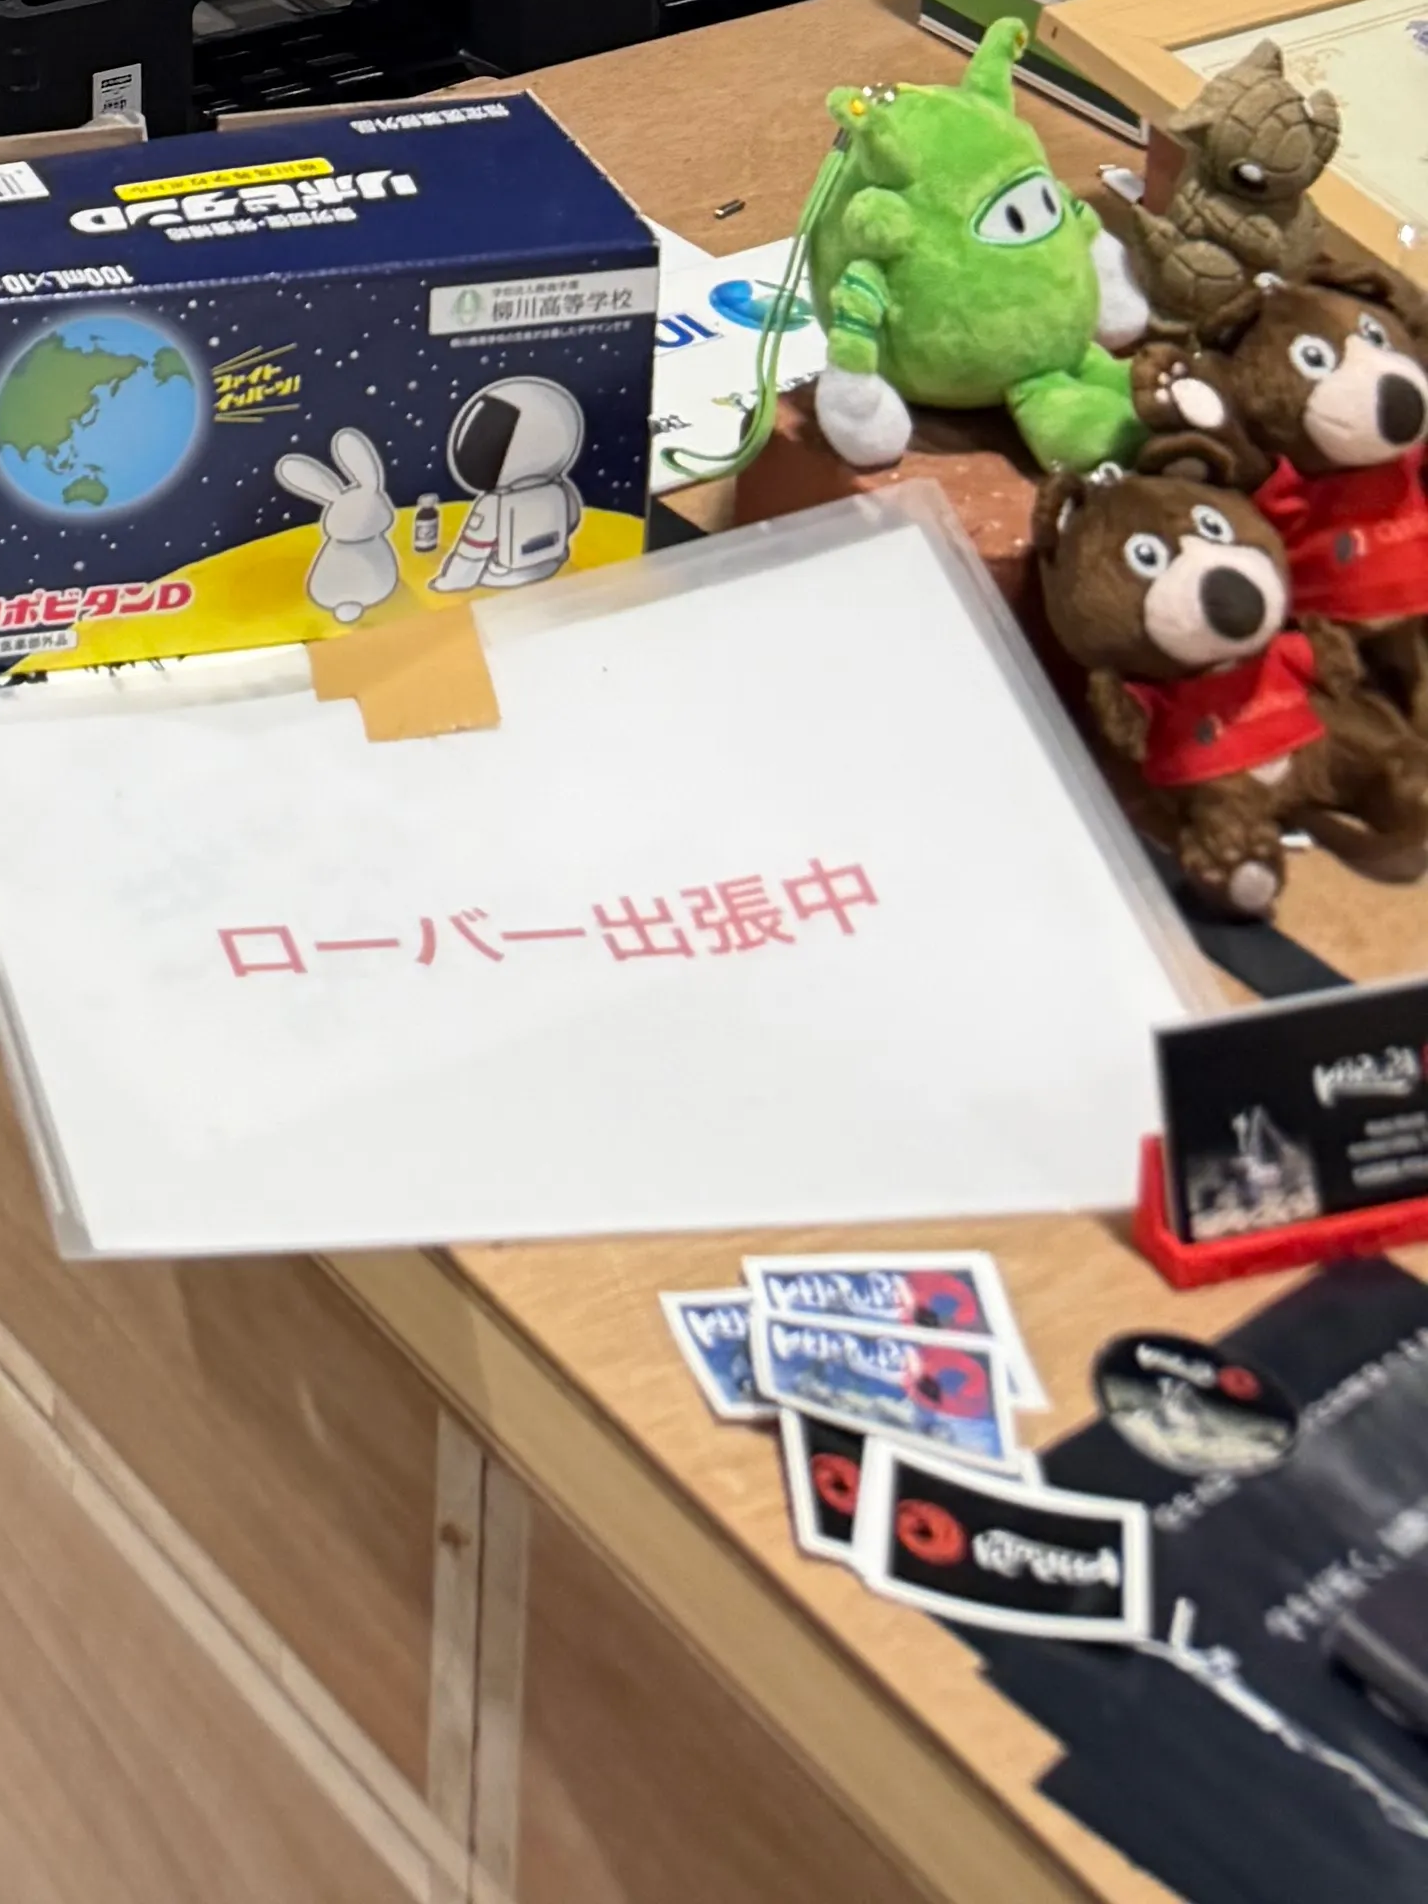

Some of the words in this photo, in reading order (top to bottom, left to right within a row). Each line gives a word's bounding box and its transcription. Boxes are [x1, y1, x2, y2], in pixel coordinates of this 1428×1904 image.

[69, 169, 418, 234] リポビタンD
[492, 289, 634, 322] 柳川高等学校
[216, 856, 881, 978] ローバー出張中
